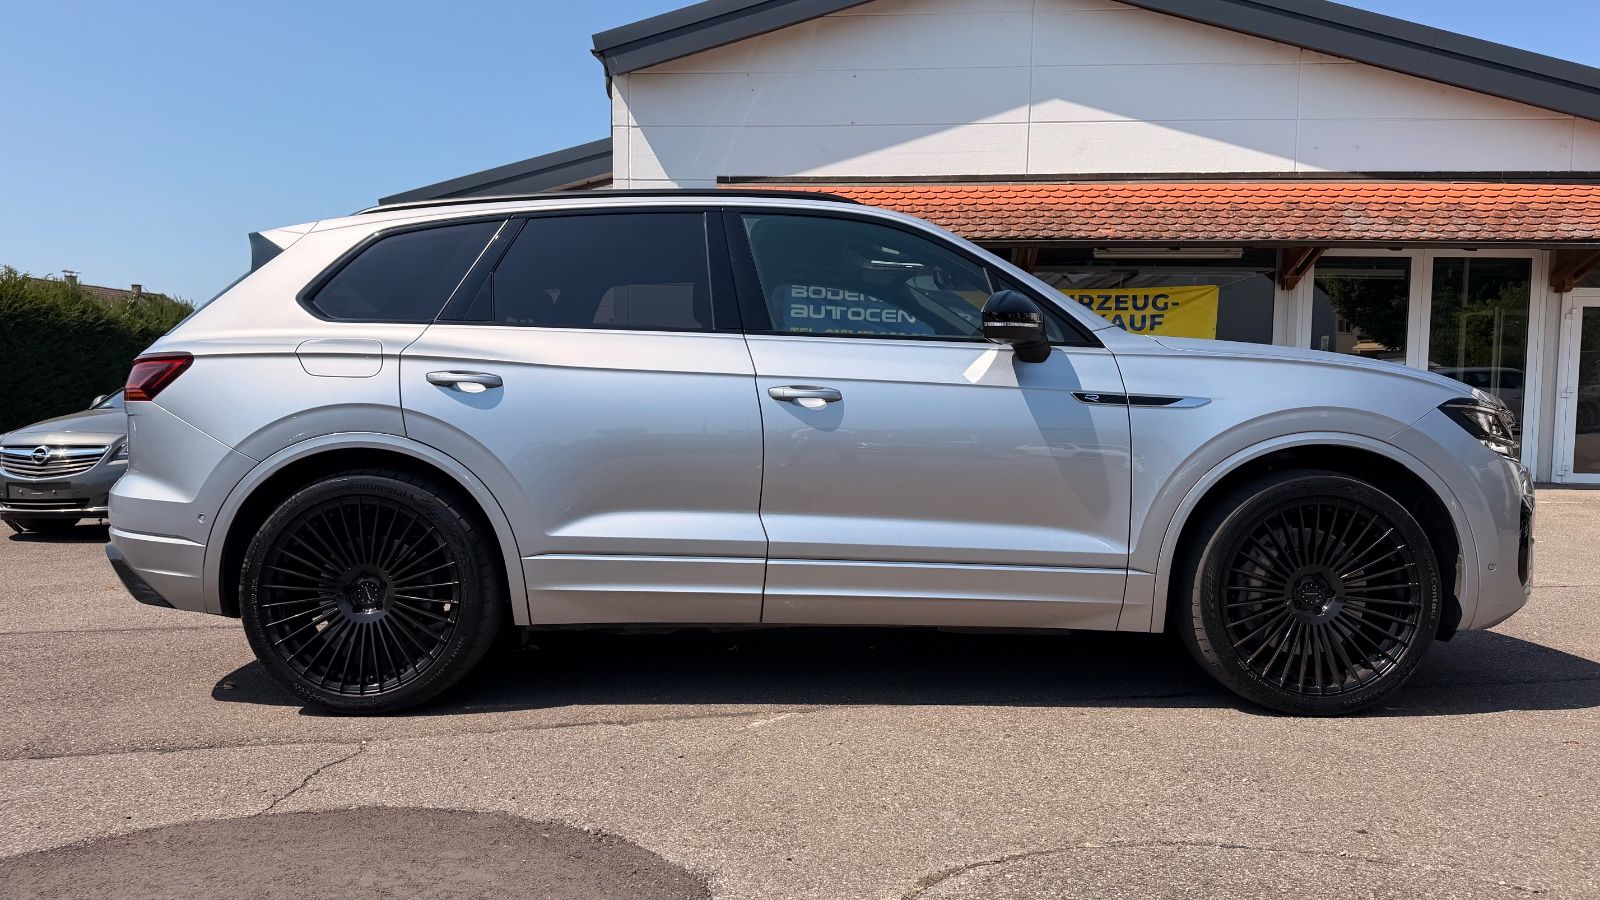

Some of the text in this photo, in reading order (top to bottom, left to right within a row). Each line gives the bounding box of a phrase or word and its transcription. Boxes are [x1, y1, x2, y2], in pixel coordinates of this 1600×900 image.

[791, 285, 884, 303] BODE
[1069, 293, 1180, 311] RZEUG-
[1101, 313, 1165, 331] AUF
